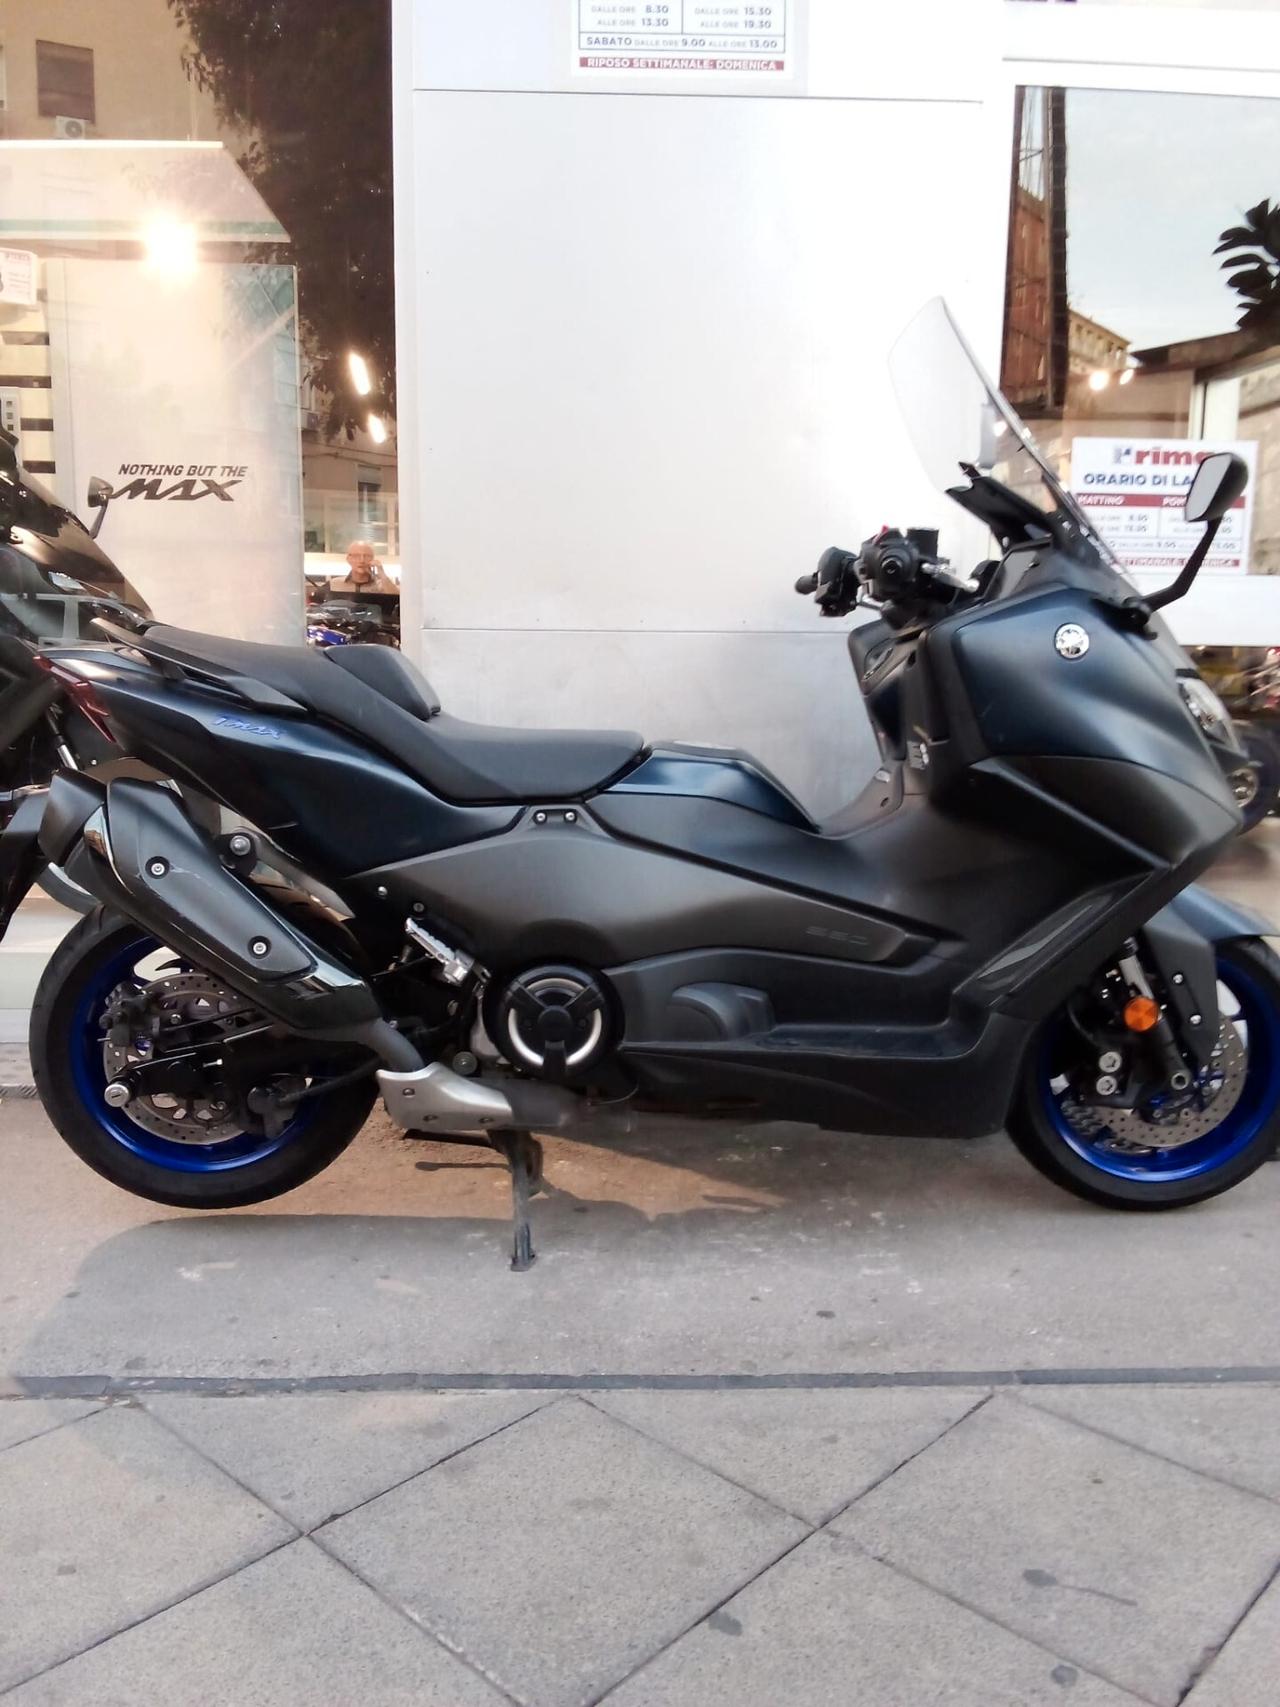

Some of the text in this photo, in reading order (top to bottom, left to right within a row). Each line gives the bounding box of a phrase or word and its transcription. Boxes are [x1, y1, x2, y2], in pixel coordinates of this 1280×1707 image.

[645, 5, 669, 14] 8.30
[744, 7, 772, 16] 15.30
[641, 18, 669, 27] 13.30
[744, 20, 772, 29] 19.30
[586, 36, 632, 46] SABATO
[681, 38, 706, 48] 9.00
[749, 40, 778, 49] 13.00
[587, 57, 632, 68] RIPOSO
[716, 60, 777, 71] DOMENICA
[118, 463, 248, 477] NOTHING BUT THE
[1083, 473, 1146, 486] ORARIO
[1151, 474, 1168, 486] DI
[108, 478, 243, 501] MAX
[1077, 496, 1124, 506] MATTINO
